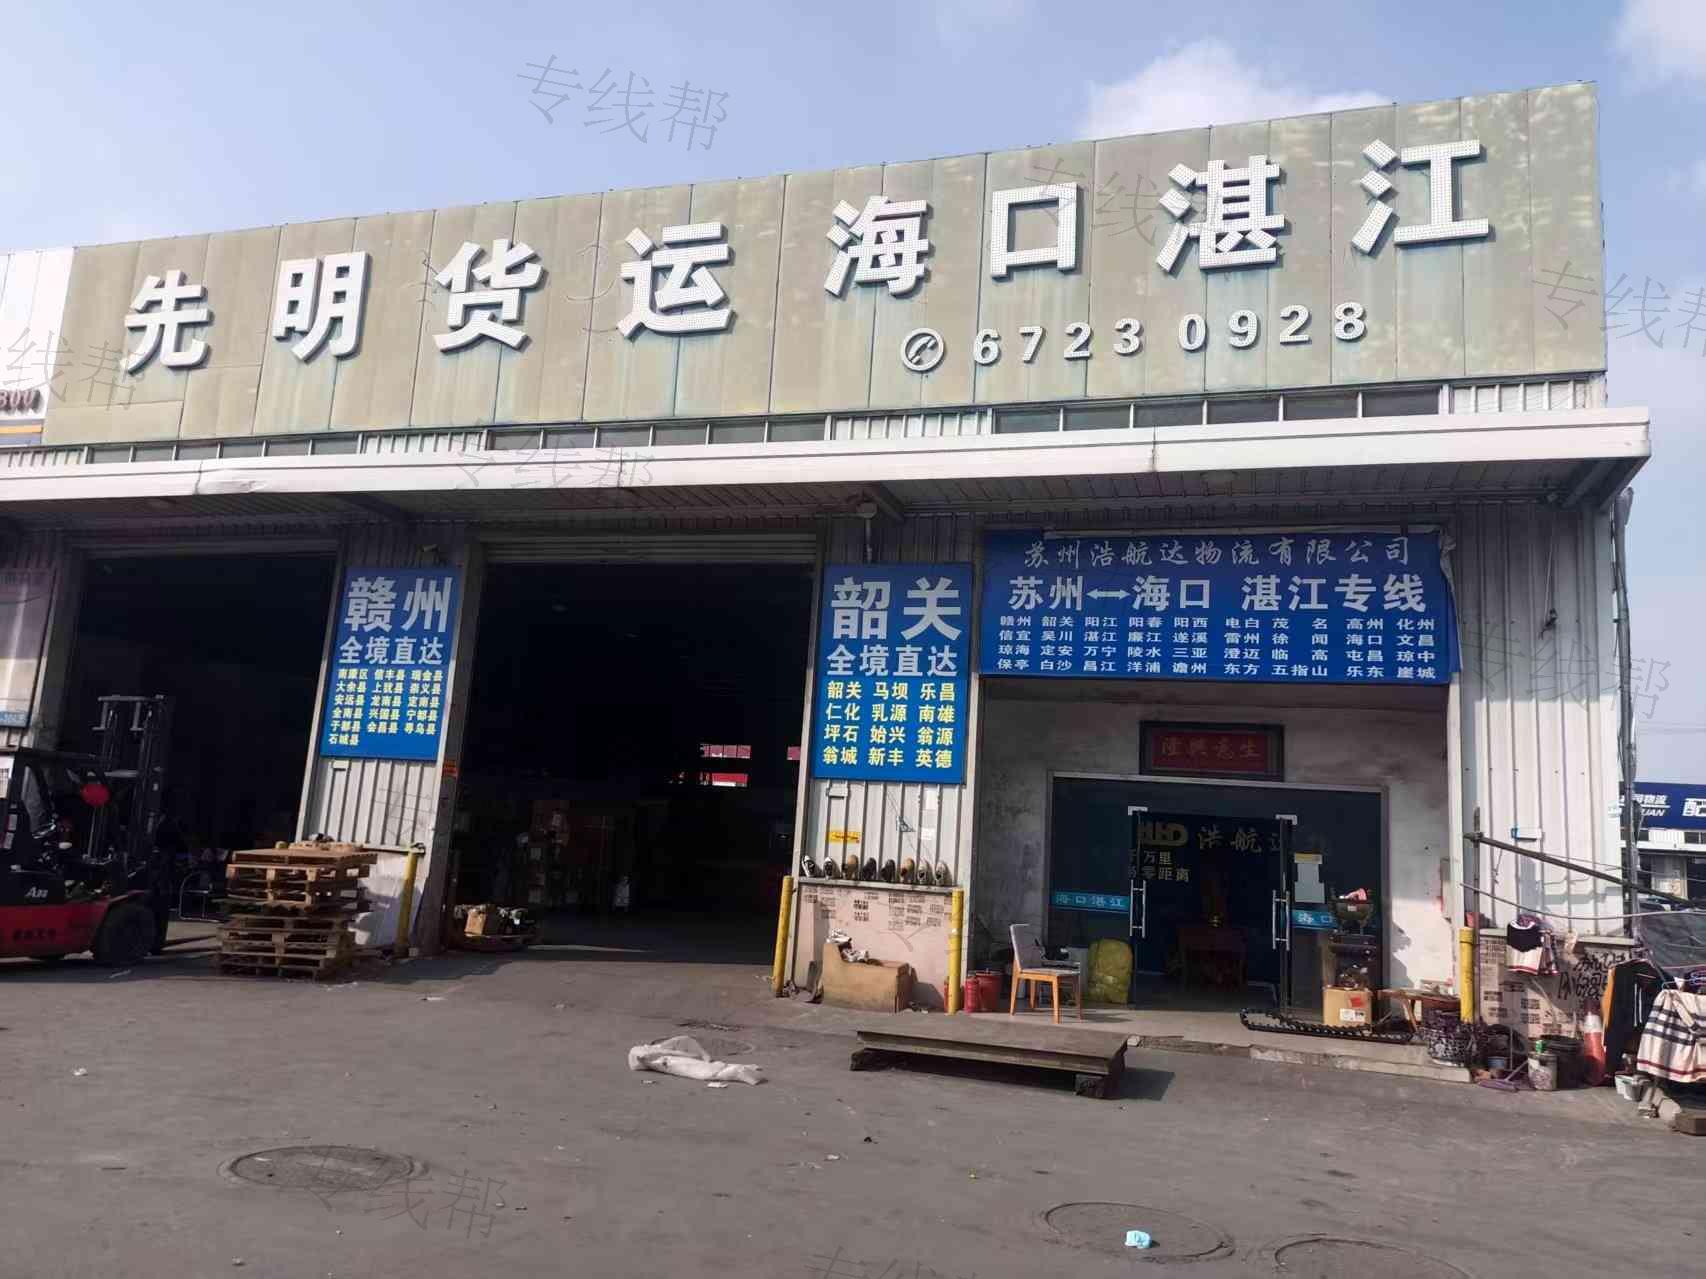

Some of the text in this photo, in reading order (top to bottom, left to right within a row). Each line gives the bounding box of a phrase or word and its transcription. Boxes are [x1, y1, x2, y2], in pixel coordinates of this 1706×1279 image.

[1024, 537, 1409, 569] 苏州浩航达物流有限公司
[344, 577, 453, 632] 赣州
[1242, 574, 1427, 613] 湛江专线
[832, 576, 962, 641] 韶关
[1085, 616, 1118, 627] 阳江
[1128, 616, 1165, 628] 阳春
[1174, 616, 1209, 628] 阳西
[1225, 617, 1260, 629] 电白
[1345, 618, 1384, 630] 高州
[1396, 618, 1435, 630] 化州
[339, 636, 443, 665] 全境直达
[1346, 634, 1383, 646] 海口
[1396, 634, 1434, 646] 文昌
[827, 644, 957, 678] 全境直达
[1041, 645, 1073, 656] 定安
[1084, 646, 1116, 657] 万宁
[1172, 647, 1208, 658] 三亚
[1041, 660, 1073, 671] 白沙
[1224, 664, 1260, 675] 东方
[1272, 664, 1328, 677] 五指山
[1346, 665, 1385, 678] 乐东
[827, 681, 955, 702] 韶关 马坝 乐昌
[825, 703, 956, 724] 仁化 乳源 南雄
[824, 724, 953, 746] 坪石 始兴 翁源
[822, 746, 953, 769] 翁城 新丰 英德
